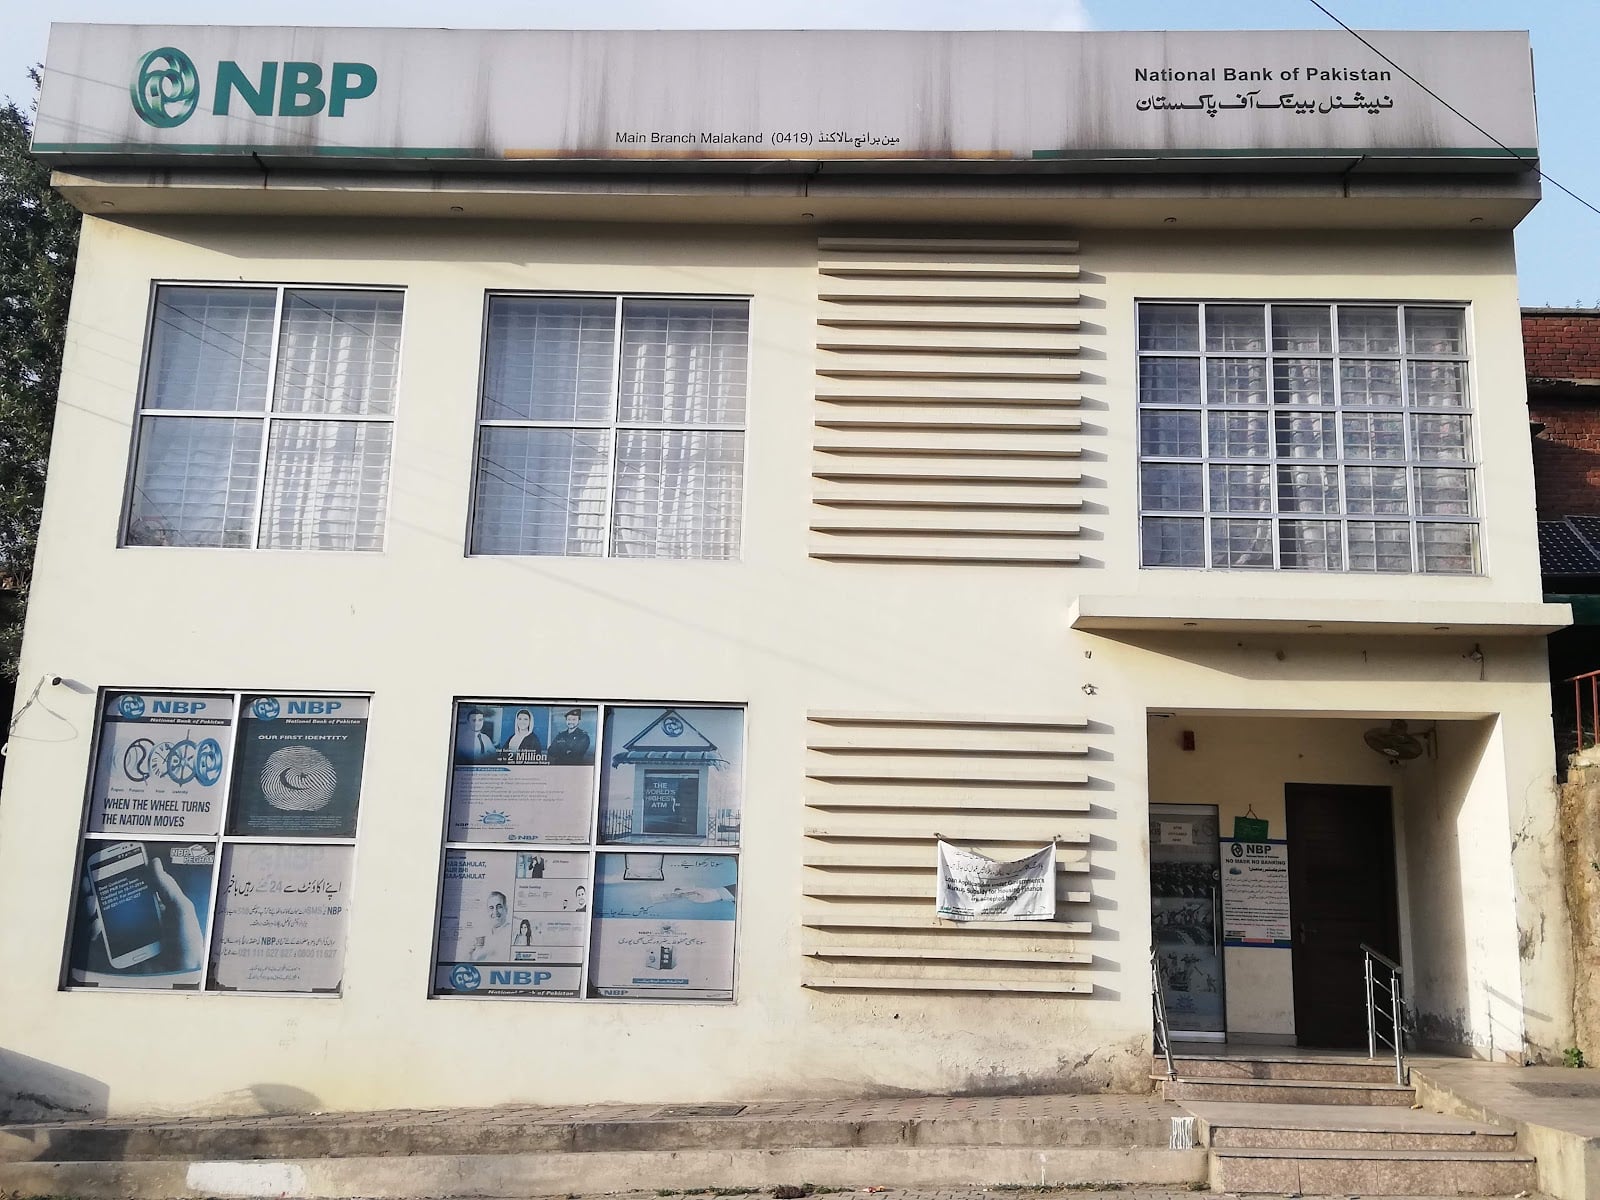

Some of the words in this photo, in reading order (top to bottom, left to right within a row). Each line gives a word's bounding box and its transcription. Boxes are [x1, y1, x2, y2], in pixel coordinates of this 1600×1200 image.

[1135, 68, 1216, 82] National
[1223, 68, 1273, 82] Bank
[1280, 67, 1300, 82] of
[1306, 67, 1392, 82] Pakistan
[212, 60, 378, 118] NBP
[1136, 94, 1217, 118] پاکستان
[1219, 89, 1261, 110] آف
[1256, 93, 1315, 115] بینک
[1318, 91, 1394, 114] نیشنل
[615, 132, 647, 144] Main
[651, 132, 696, 144] Branch
[700, 132, 763, 145] Malakand
[771, 132, 813, 146] (0419)
[854, 134, 881, 148] برانچ
[882, 135, 900, 146] مین
[152, 700, 207, 714] NBP
[287, 701, 342, 714] NBP
[508, 753, 513, 761] 2
[516, 752, 547, 761] Million
[104, 798, 130, 810] WHEN
[132, 799, 149, 811] THE
[150, 799, 179, 812] WHEEL
[181, 801, 211, 813] TURNS
[102, 813, 117, 825] THE
[119, 814, 152, 826] NATION
[153, 815, 185, 827] MOVES
[1246, 844, 1272, 854] NBP
[269, 880, 283, 893] 24
[283, 885, 297, 893] سے
[325, 881, 342, 900] اپنے
[967, 887, 987, 895] Subsidy
[997, 886, 1020, 894] Housing
[1020, 884, 1043, 892] Finance
[327, 906, 342, 915] NBP
[261, 936, 276, 946] NBP
[489, 970, 552, 985] NBP
